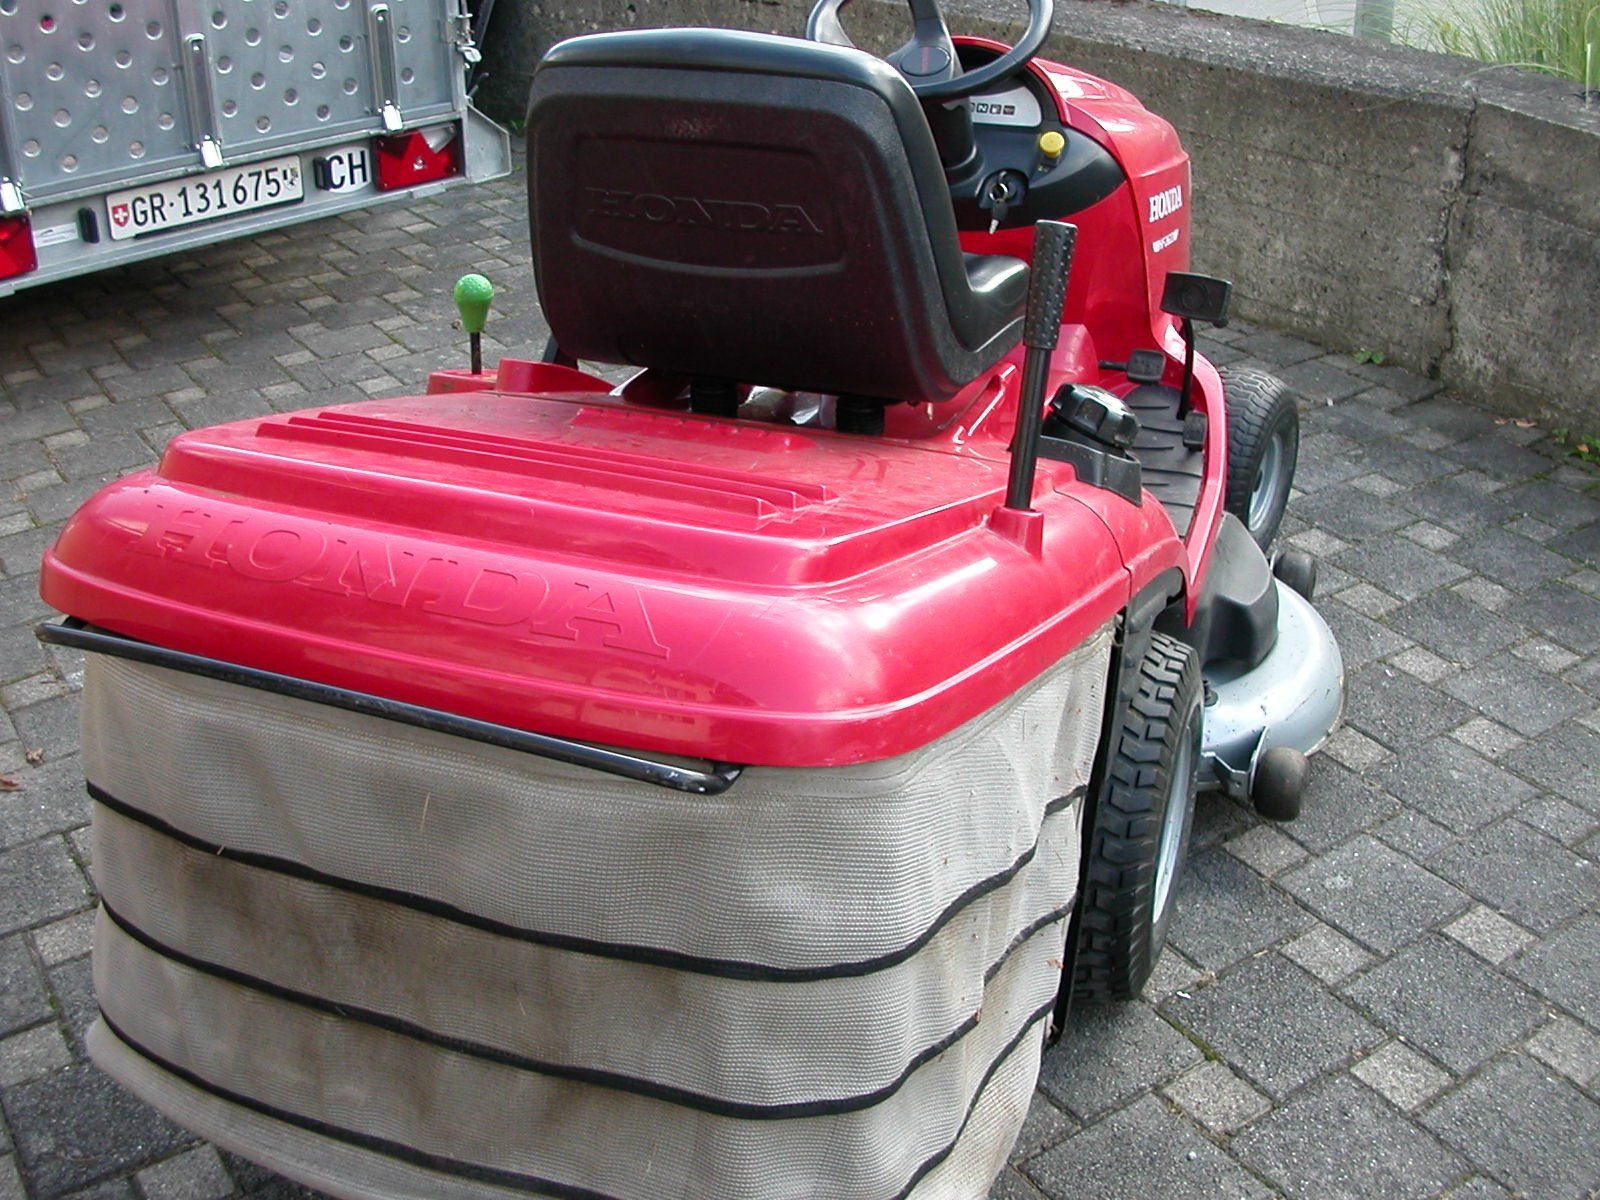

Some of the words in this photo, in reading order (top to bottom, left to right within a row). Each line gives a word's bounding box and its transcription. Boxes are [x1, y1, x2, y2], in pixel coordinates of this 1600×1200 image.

[330, 151, 368, 190] CH
[585, 187, 823, 234] HONDA
[1149, 185, 1182, 222] HONDA
[127, 503, 670, 658] HONDA
